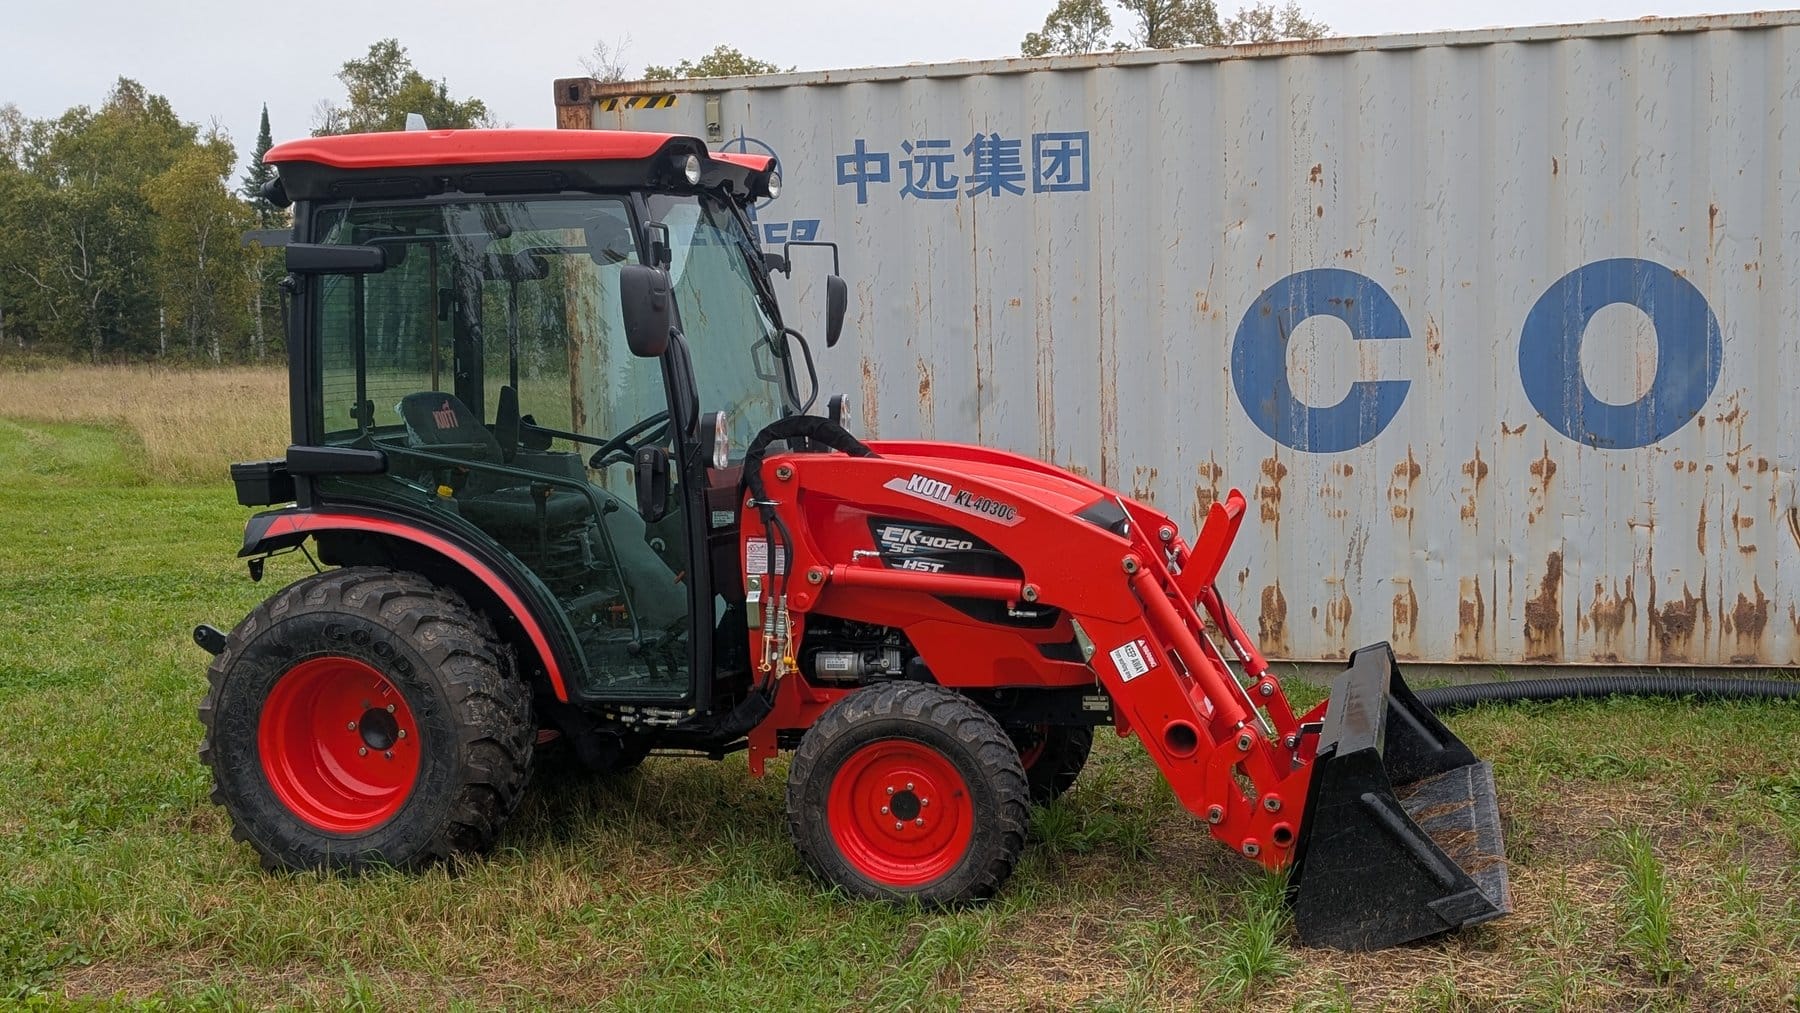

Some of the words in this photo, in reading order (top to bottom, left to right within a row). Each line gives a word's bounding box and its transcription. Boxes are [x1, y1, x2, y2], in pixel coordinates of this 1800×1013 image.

[836, 131, 1091, 204] 中远集团
[907, 474, 952, 501] KIOTI
[954, 490, 1018, 520] KL4030C
[889, 543, 915, 554] SE
[902, 559, 944, 573] HST
[1124, 644, 1137, 658] KEEP
[1130, 657, 1144, 674] AWAY
